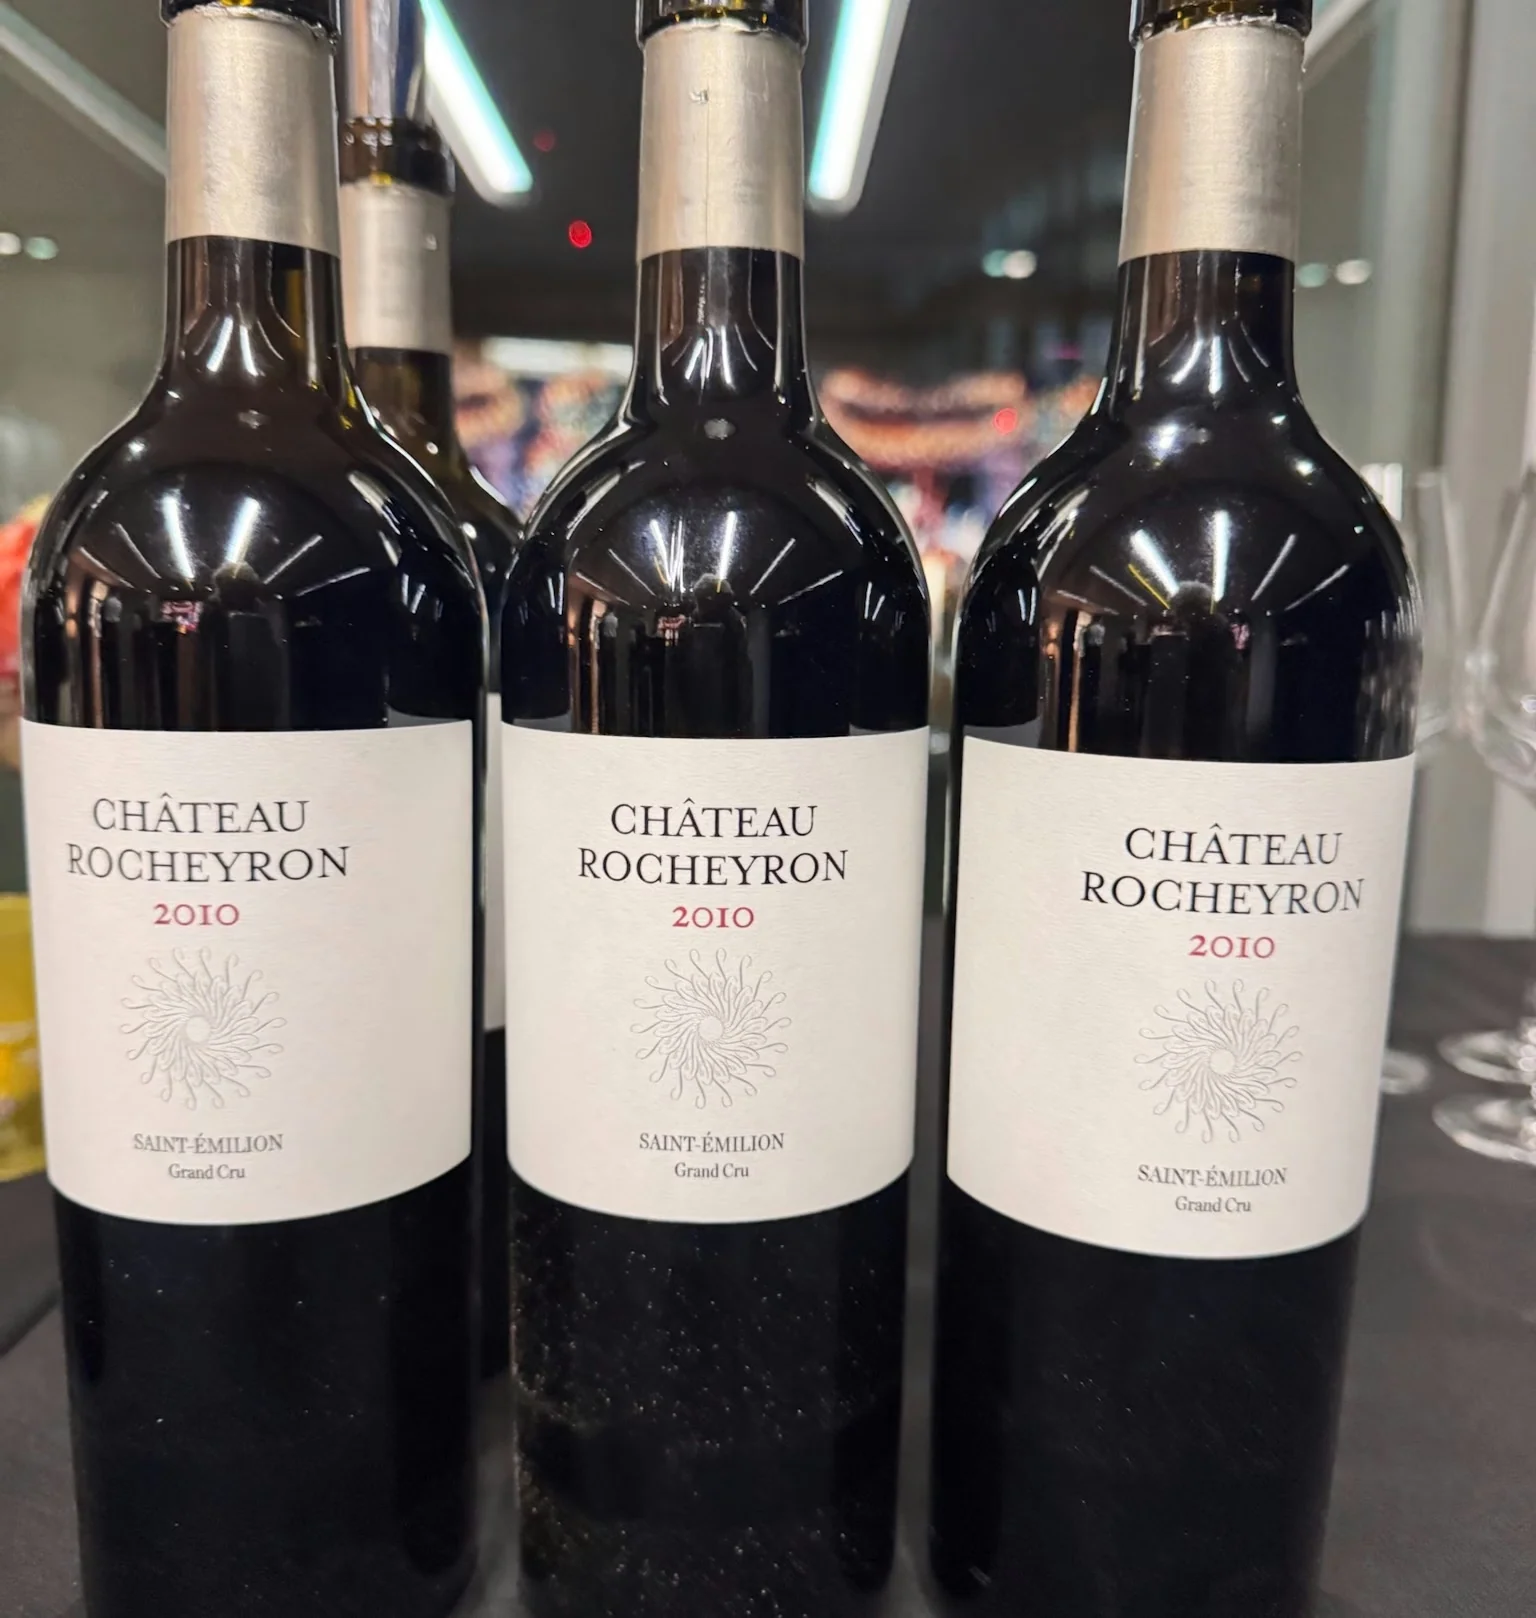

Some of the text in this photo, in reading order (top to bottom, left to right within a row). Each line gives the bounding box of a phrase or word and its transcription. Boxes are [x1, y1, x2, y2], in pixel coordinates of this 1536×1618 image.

[92, 791, 310, 834] CHÂTEAU
[610, 797, 818, 839] CHÂTEAU
[1125, 822, 1343, 866] CHÂTEAU
[67, 843, 351, 883] ROCHEYRON
[577, 846, 849, 886] ROCHEYRON
[1080, 870, 1365, 915] ROCHEYRON
[153, 903, 240, 926] 2010
[671, 906, 755, 929] 2010
[1188, 934, 1276, 959] 2010
[133, 1132, 284, 1155] SAINT-ÉMILION
[639, 1131, 785, 1154] SAINT-ÉMILION
[168, 1163, 246, 1180] Grand Cru
[674, 1162, 750, 1179] Grand Cru
[1137, 1163, 1288, 1187] SAINT-ÉMILION
[1175, 1195, 1252, 1213] Grand Cru
